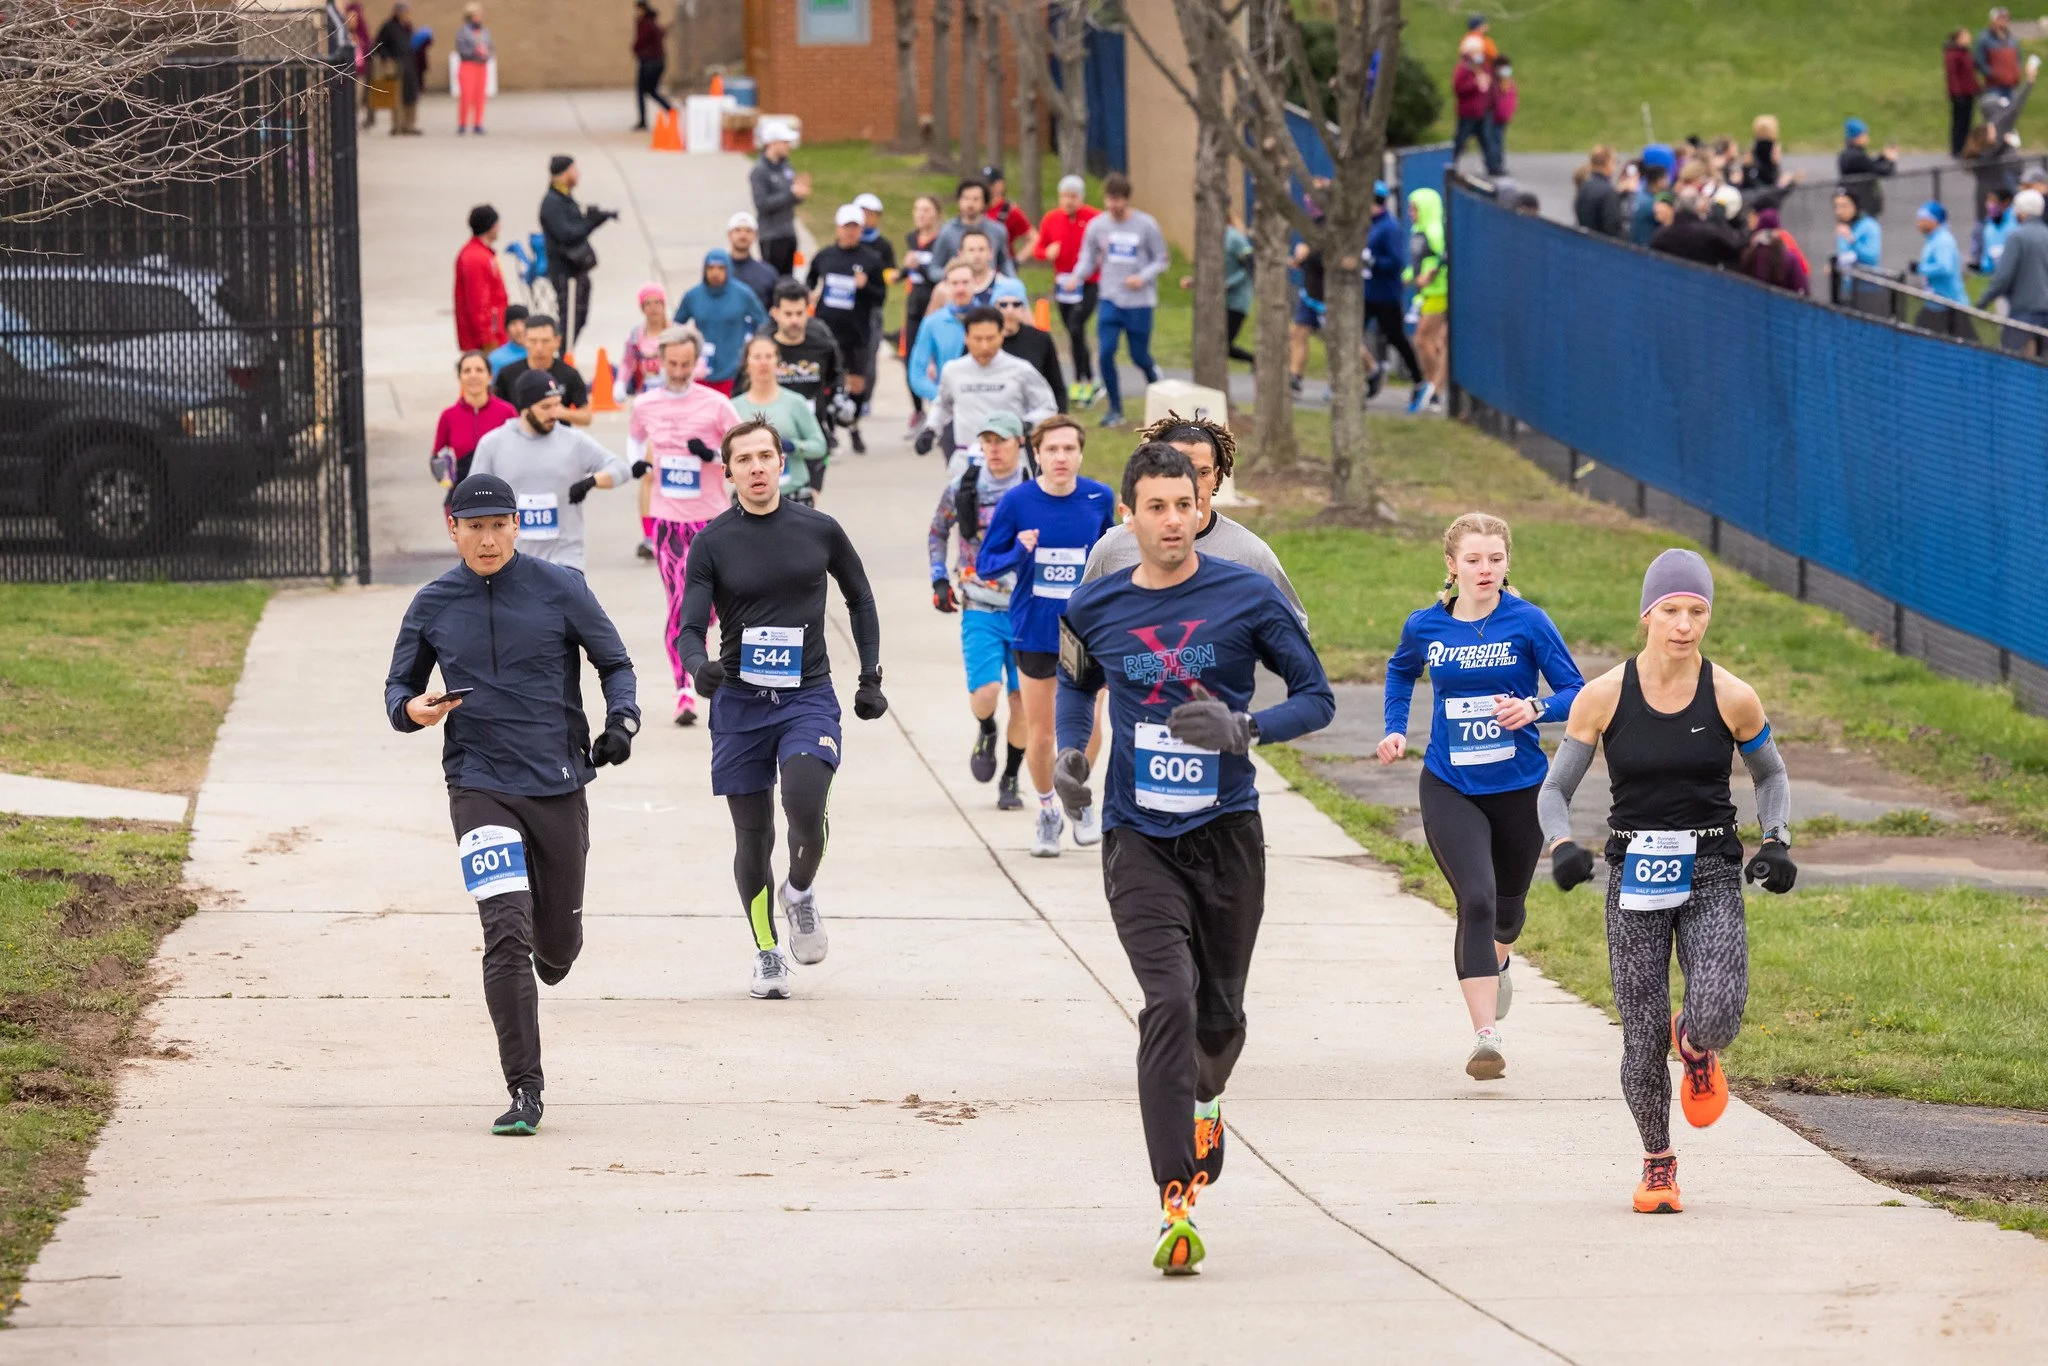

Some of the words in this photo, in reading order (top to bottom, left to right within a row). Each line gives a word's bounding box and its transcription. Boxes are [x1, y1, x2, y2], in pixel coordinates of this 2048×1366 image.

[524, 510, 553, 525] 818
[1043, 566, 1077, 582] 628
[752, 648, 791, 666] 544
[1123, 643, 1216, 673] RESTON
[1428, 641, 1511, 666] RIVERSIDE
[1460, 658, 1487, 669] TRACK
[1488, 659, 1494, 667] &
[1496, 655, 1518, 667] FIELD
[1143, 664, 1203, 685] MILER
[1459, 720, 1501, 741] 706
[1149, 755, 1203, 783] 606
[1617, 830, 1631, 839] TYR
[1708, 828, 1724, 837] TYR
[472, 847, 512, 875] 601
[1636, 859, 1682, 882] 623
[489, 872, 516, 881] MARATHON
